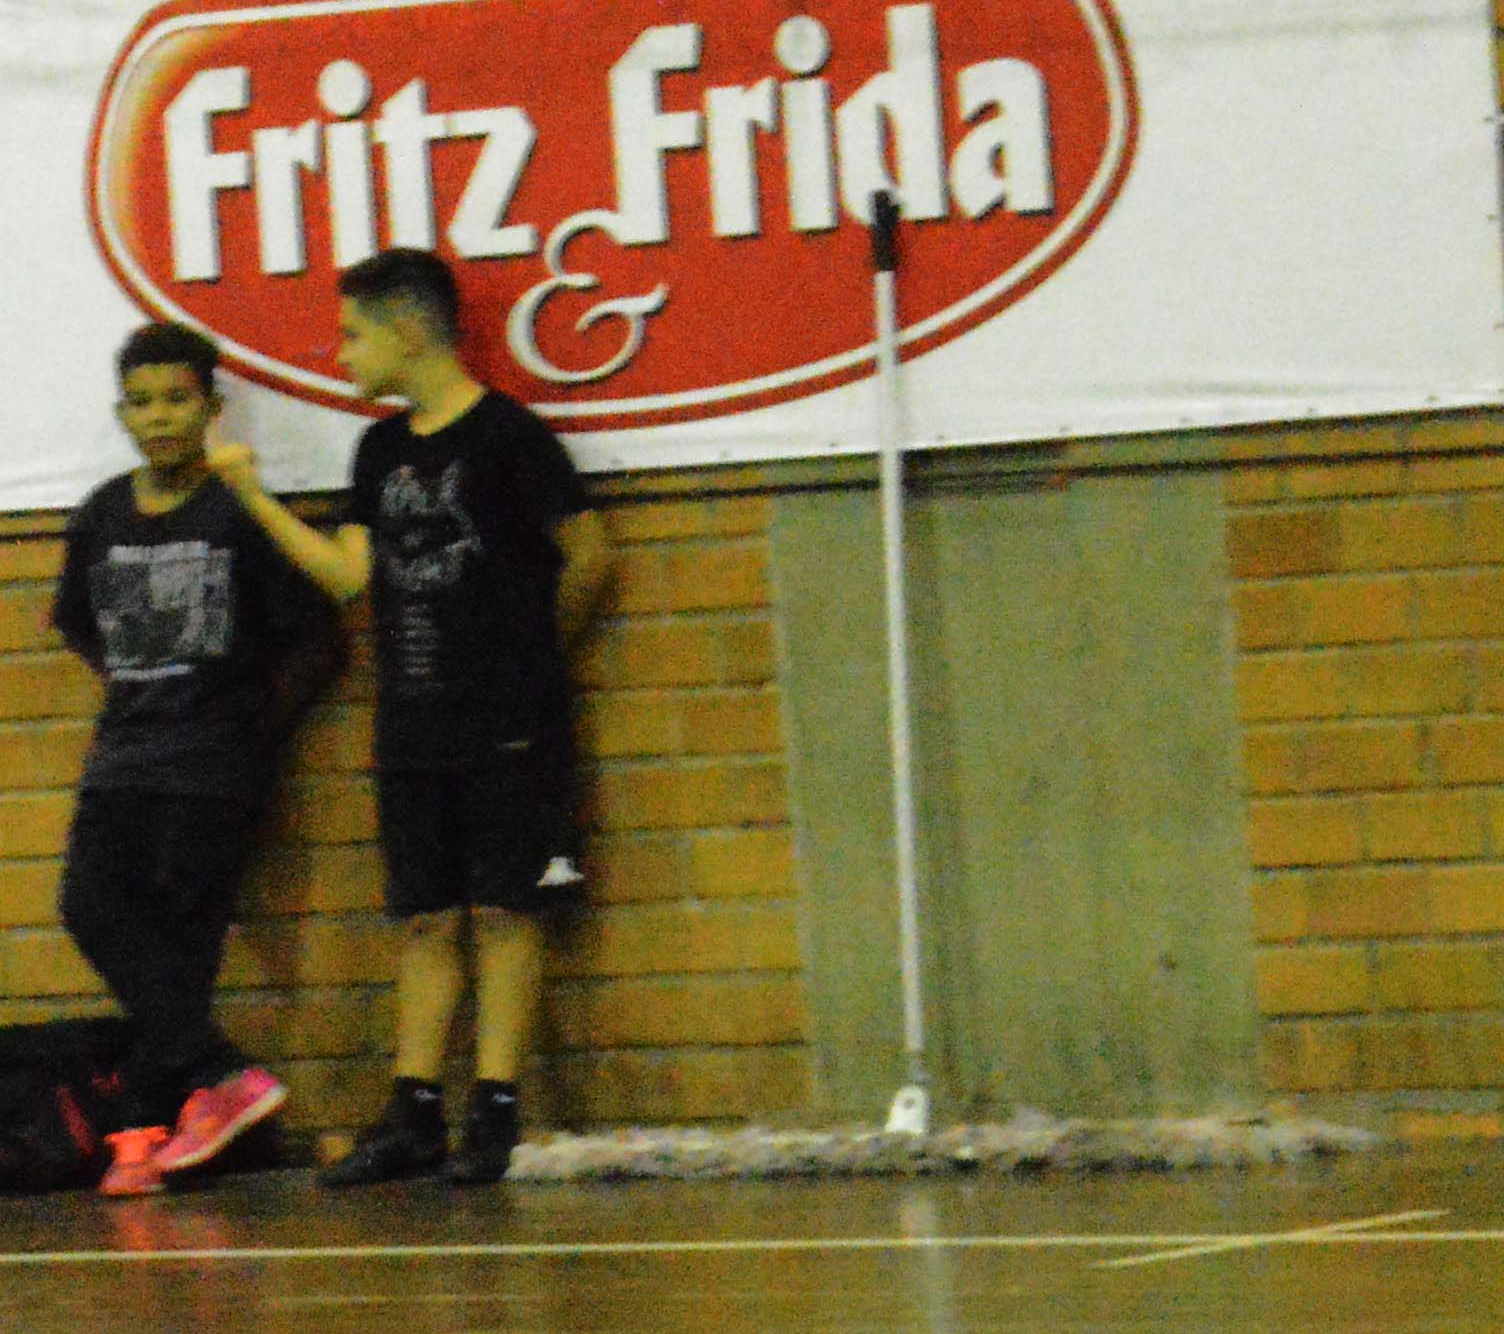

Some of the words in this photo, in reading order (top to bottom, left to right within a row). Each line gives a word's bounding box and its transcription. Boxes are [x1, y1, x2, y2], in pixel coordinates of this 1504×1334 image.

[163, 58, 541, 283] Fritz
[506, 210, 669, 384] &
[610, 3, 1054, 245] Frida
